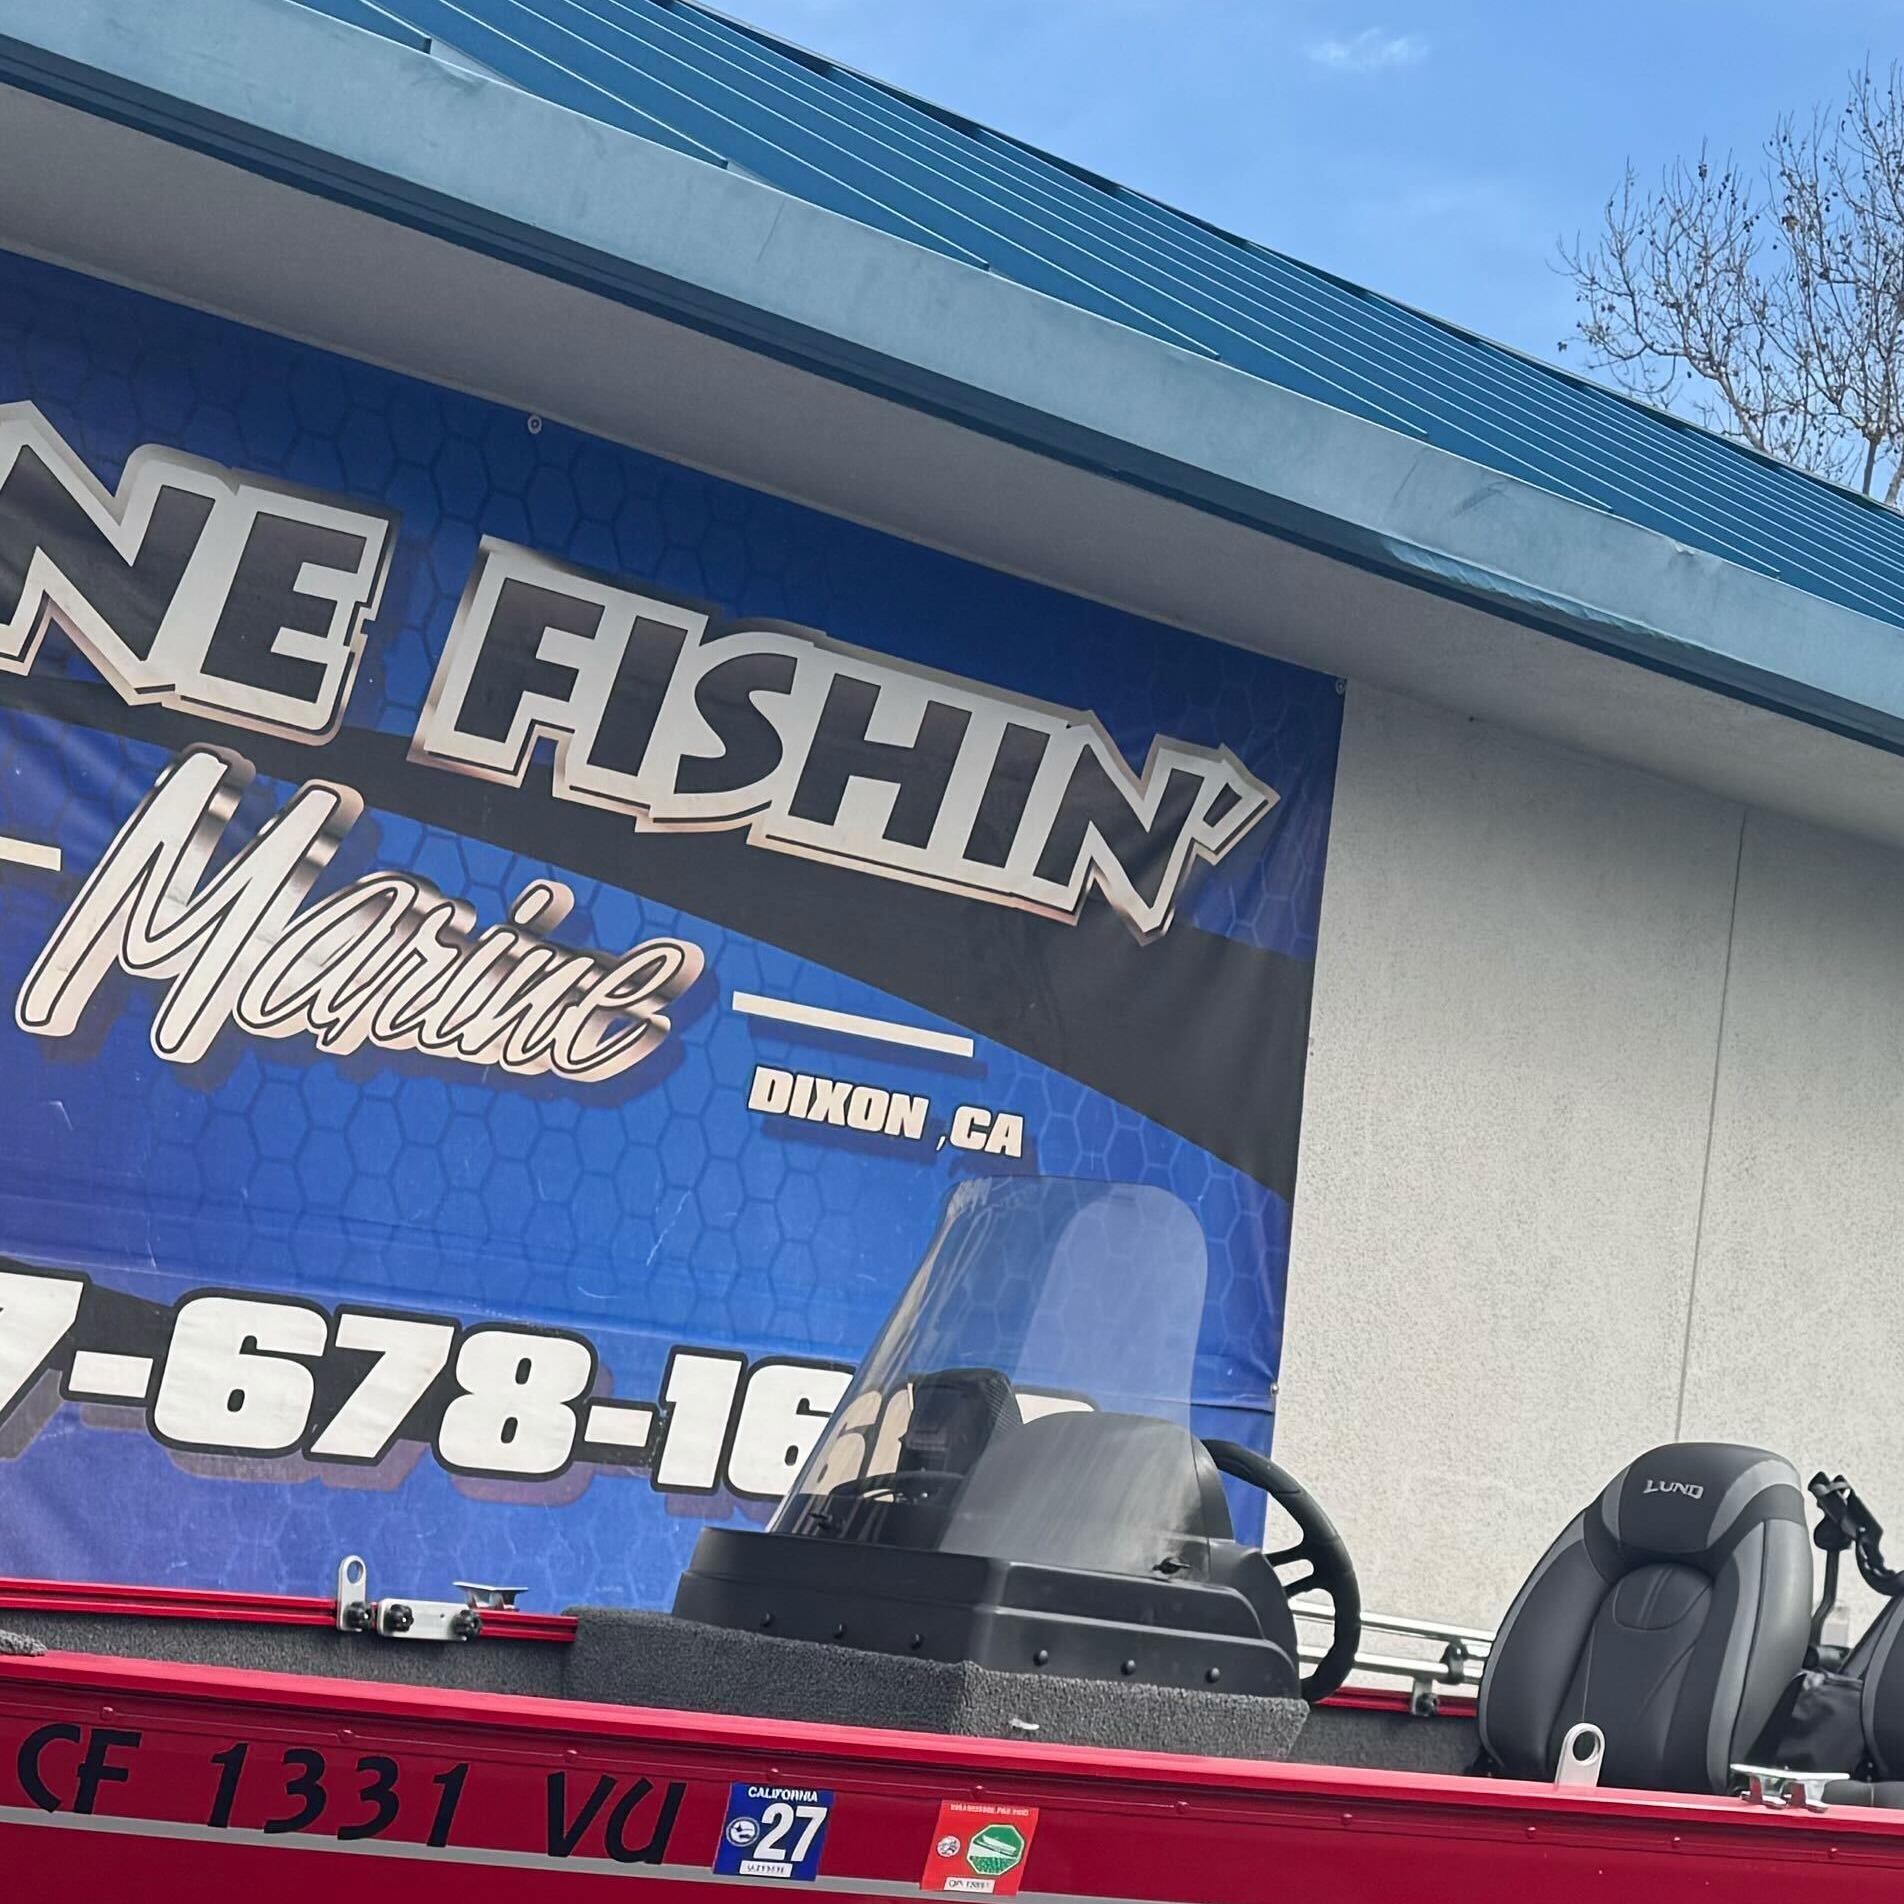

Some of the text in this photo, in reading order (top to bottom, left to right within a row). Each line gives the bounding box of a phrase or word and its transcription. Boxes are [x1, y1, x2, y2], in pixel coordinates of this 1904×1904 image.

[421, 548, 1276, 940] FISHIN'
[16, 745, 706, 1082] Marine
[747, 1065, 930, 1140] DIXON
[1642, 1479, 1704, 1500] LUND
[16, 1722, 687, 1866] CF 1331 VU
[747, 1786, 818, 1803] CALIFORNIA
[753, 1802, 828, 1863] 27
